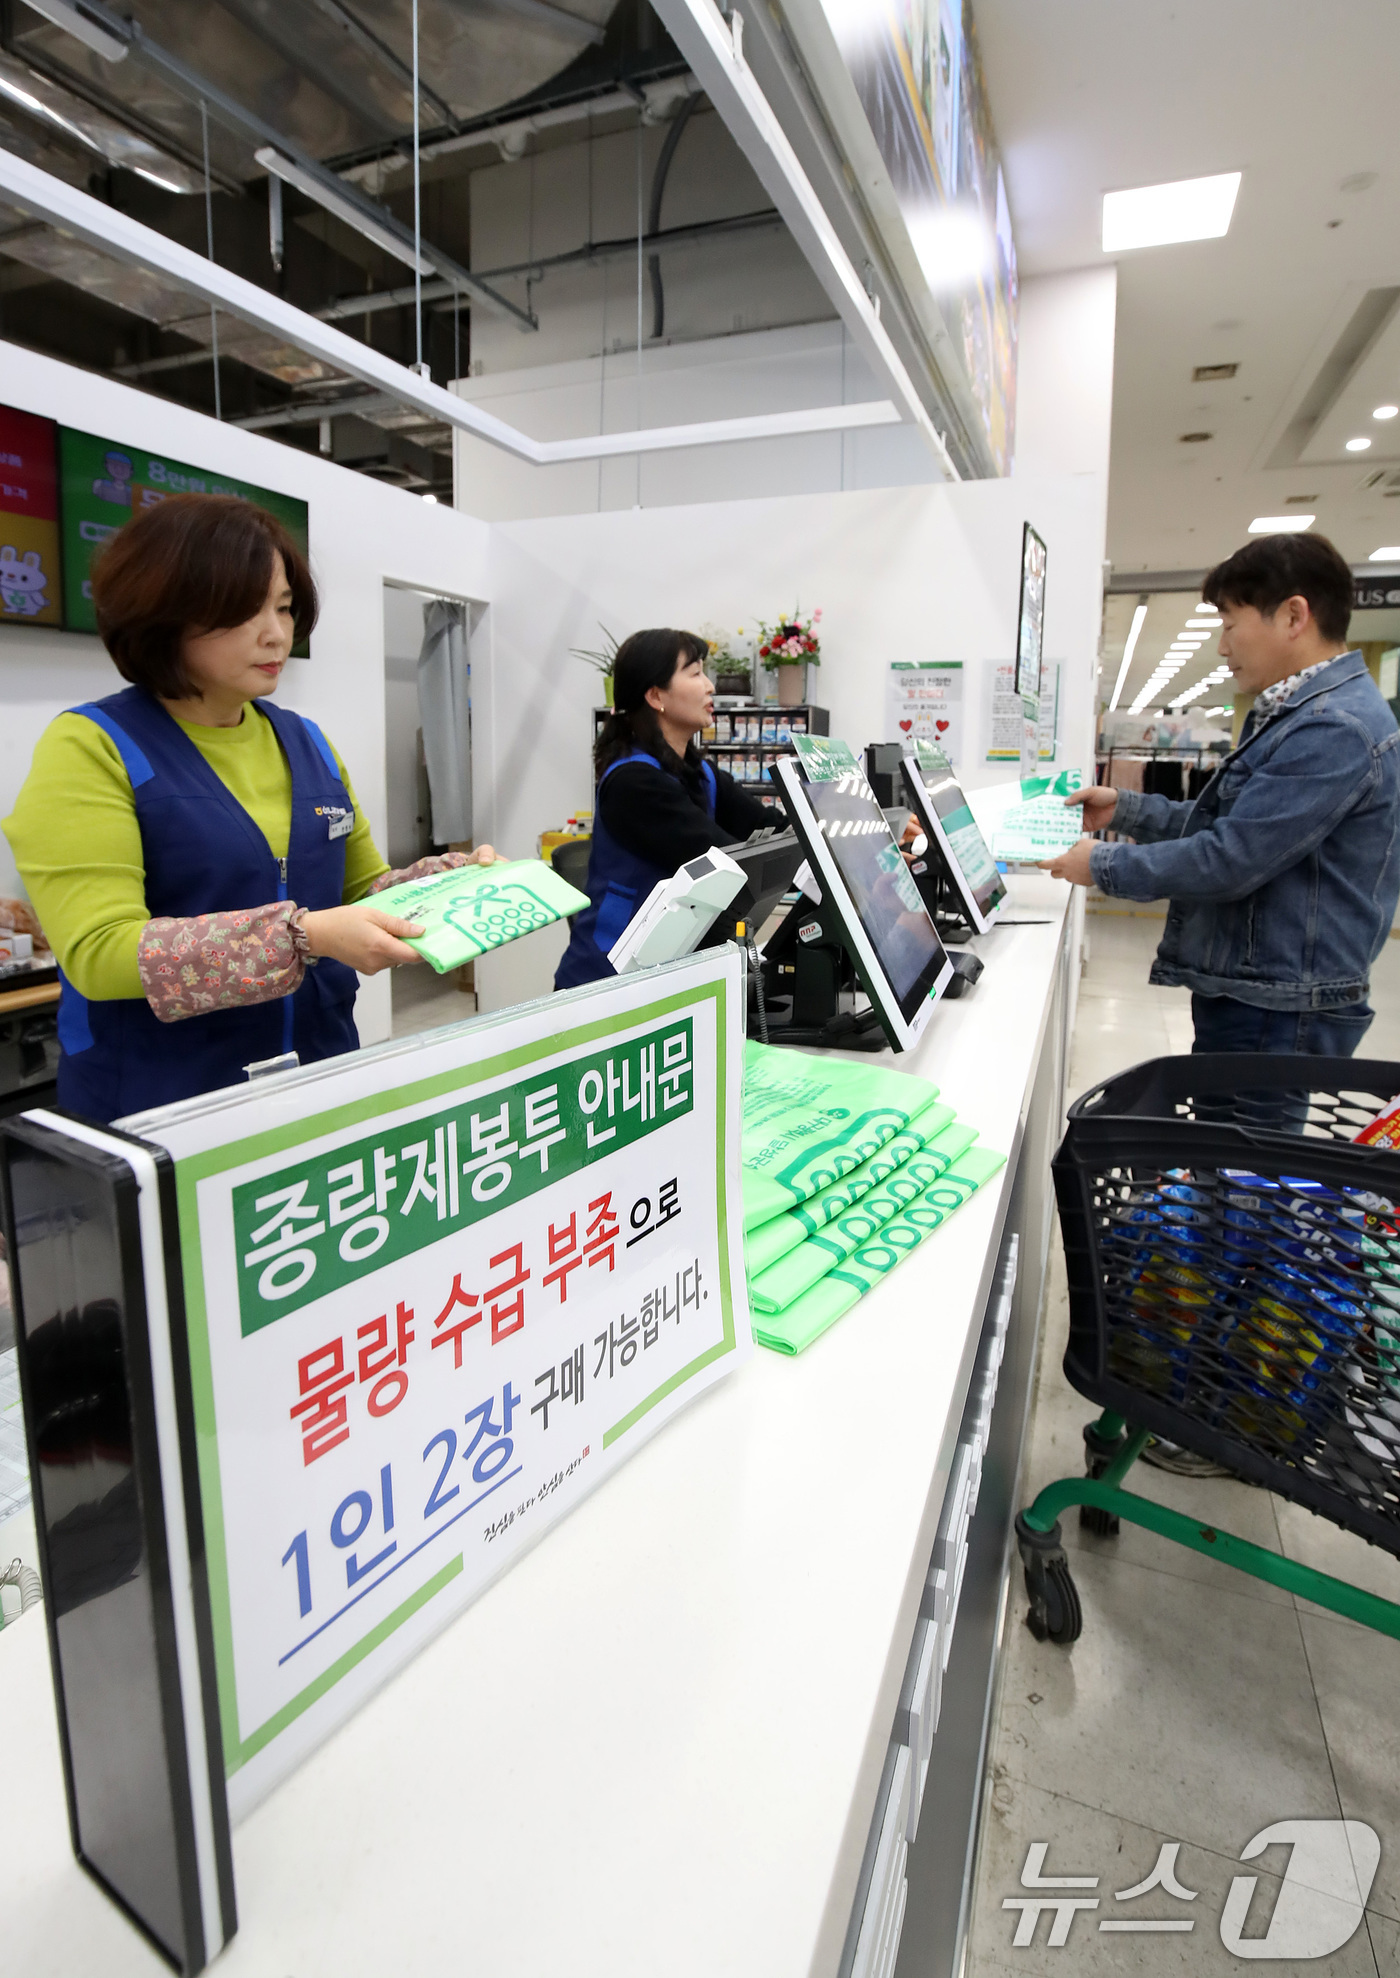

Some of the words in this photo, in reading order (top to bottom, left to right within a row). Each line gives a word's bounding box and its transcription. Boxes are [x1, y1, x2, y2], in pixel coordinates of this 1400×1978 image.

[1350, 588, 1385, 606] US
[244, 1081, 567, 1301] 종량제봉투
[578, 1029, 693, 1146] 안내문
[281, 1464, 398, 1619] 1인
[422, 1381, 522, 1518] 2장
[530, 1343, 586, 1430] 구매
[593, 1258, 709, 1379] 가능합니다.
[290, 1300, 415, 1467] 물량
[431, 1242, 531, 1369] 수급
[543, 1177, 682, 1304] 부족으로
